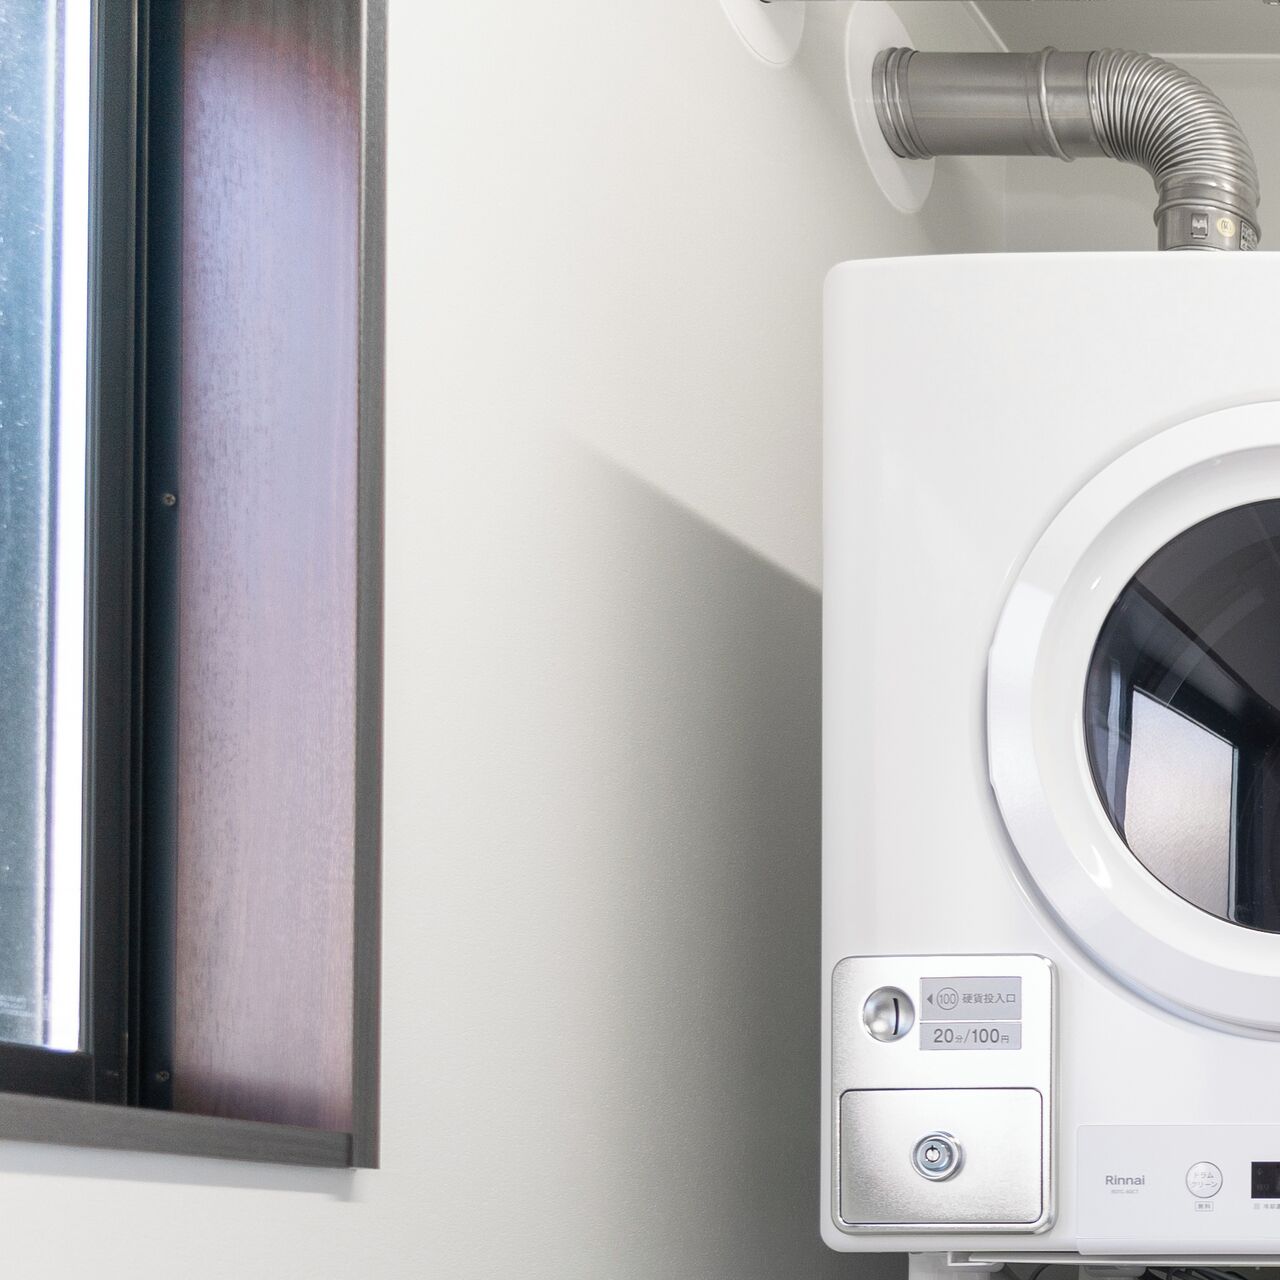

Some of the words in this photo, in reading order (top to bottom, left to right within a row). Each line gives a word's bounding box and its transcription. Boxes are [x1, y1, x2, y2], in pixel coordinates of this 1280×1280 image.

[939, 993, 957, 1004] 100
[962, 993, 1016, 1003] 硬貨投入口
[934, 1029, 1009, 1043] 20分/100円
[1105, 1175, 1145, 1186] Rinnai
[1193, 1171, 1214, 1179] ドラム
[1190, 1180, 1218, 1188] クリーン
